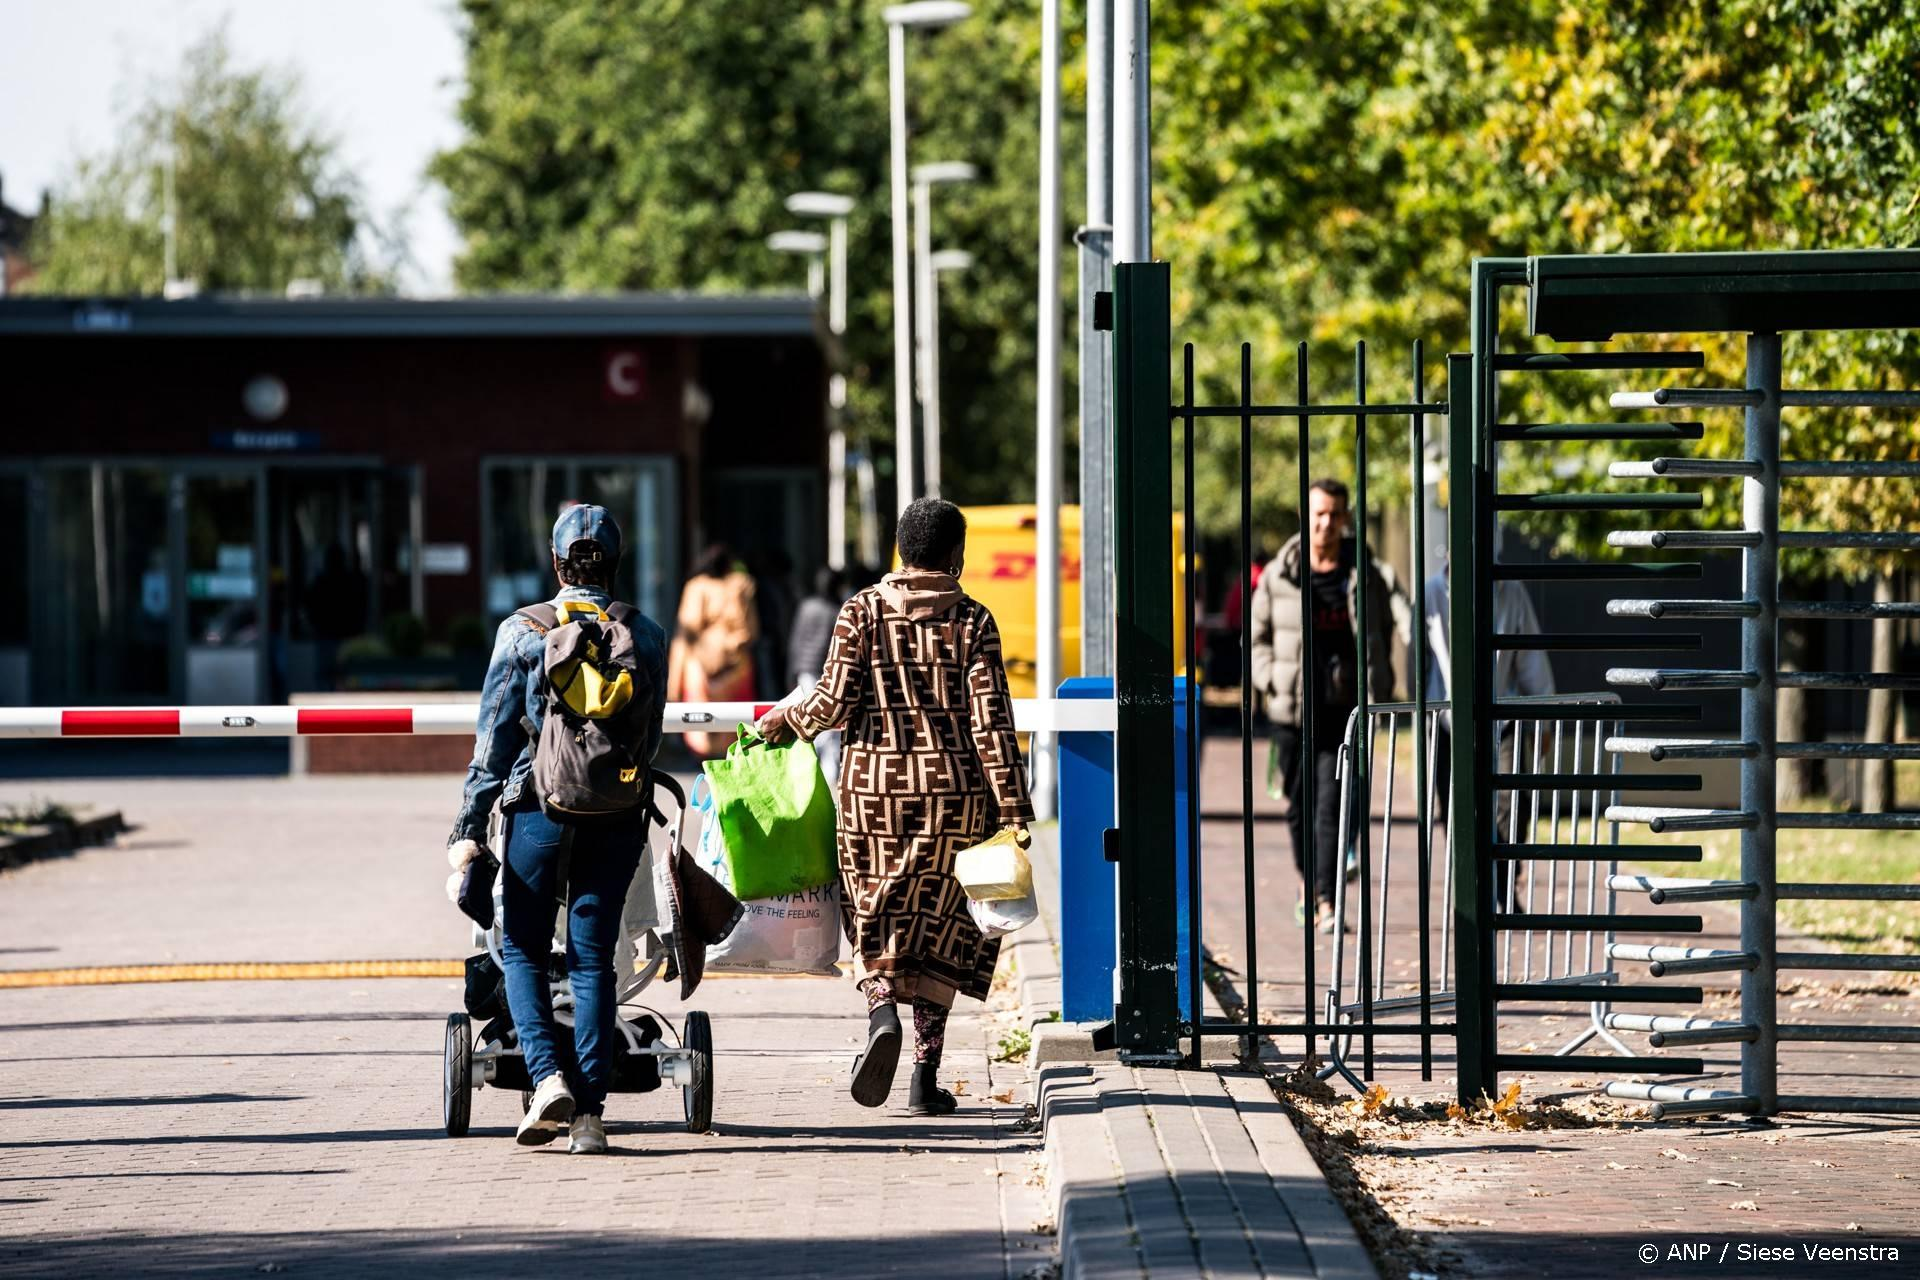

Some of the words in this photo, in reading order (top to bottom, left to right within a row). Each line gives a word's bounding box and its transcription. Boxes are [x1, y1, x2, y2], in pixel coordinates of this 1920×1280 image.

[607, 353, 640, 395] C
[744, 904, 763, 915] OVE
[767, 907, 785, 918] THE
[788, 909, 820, 919] FEELING
